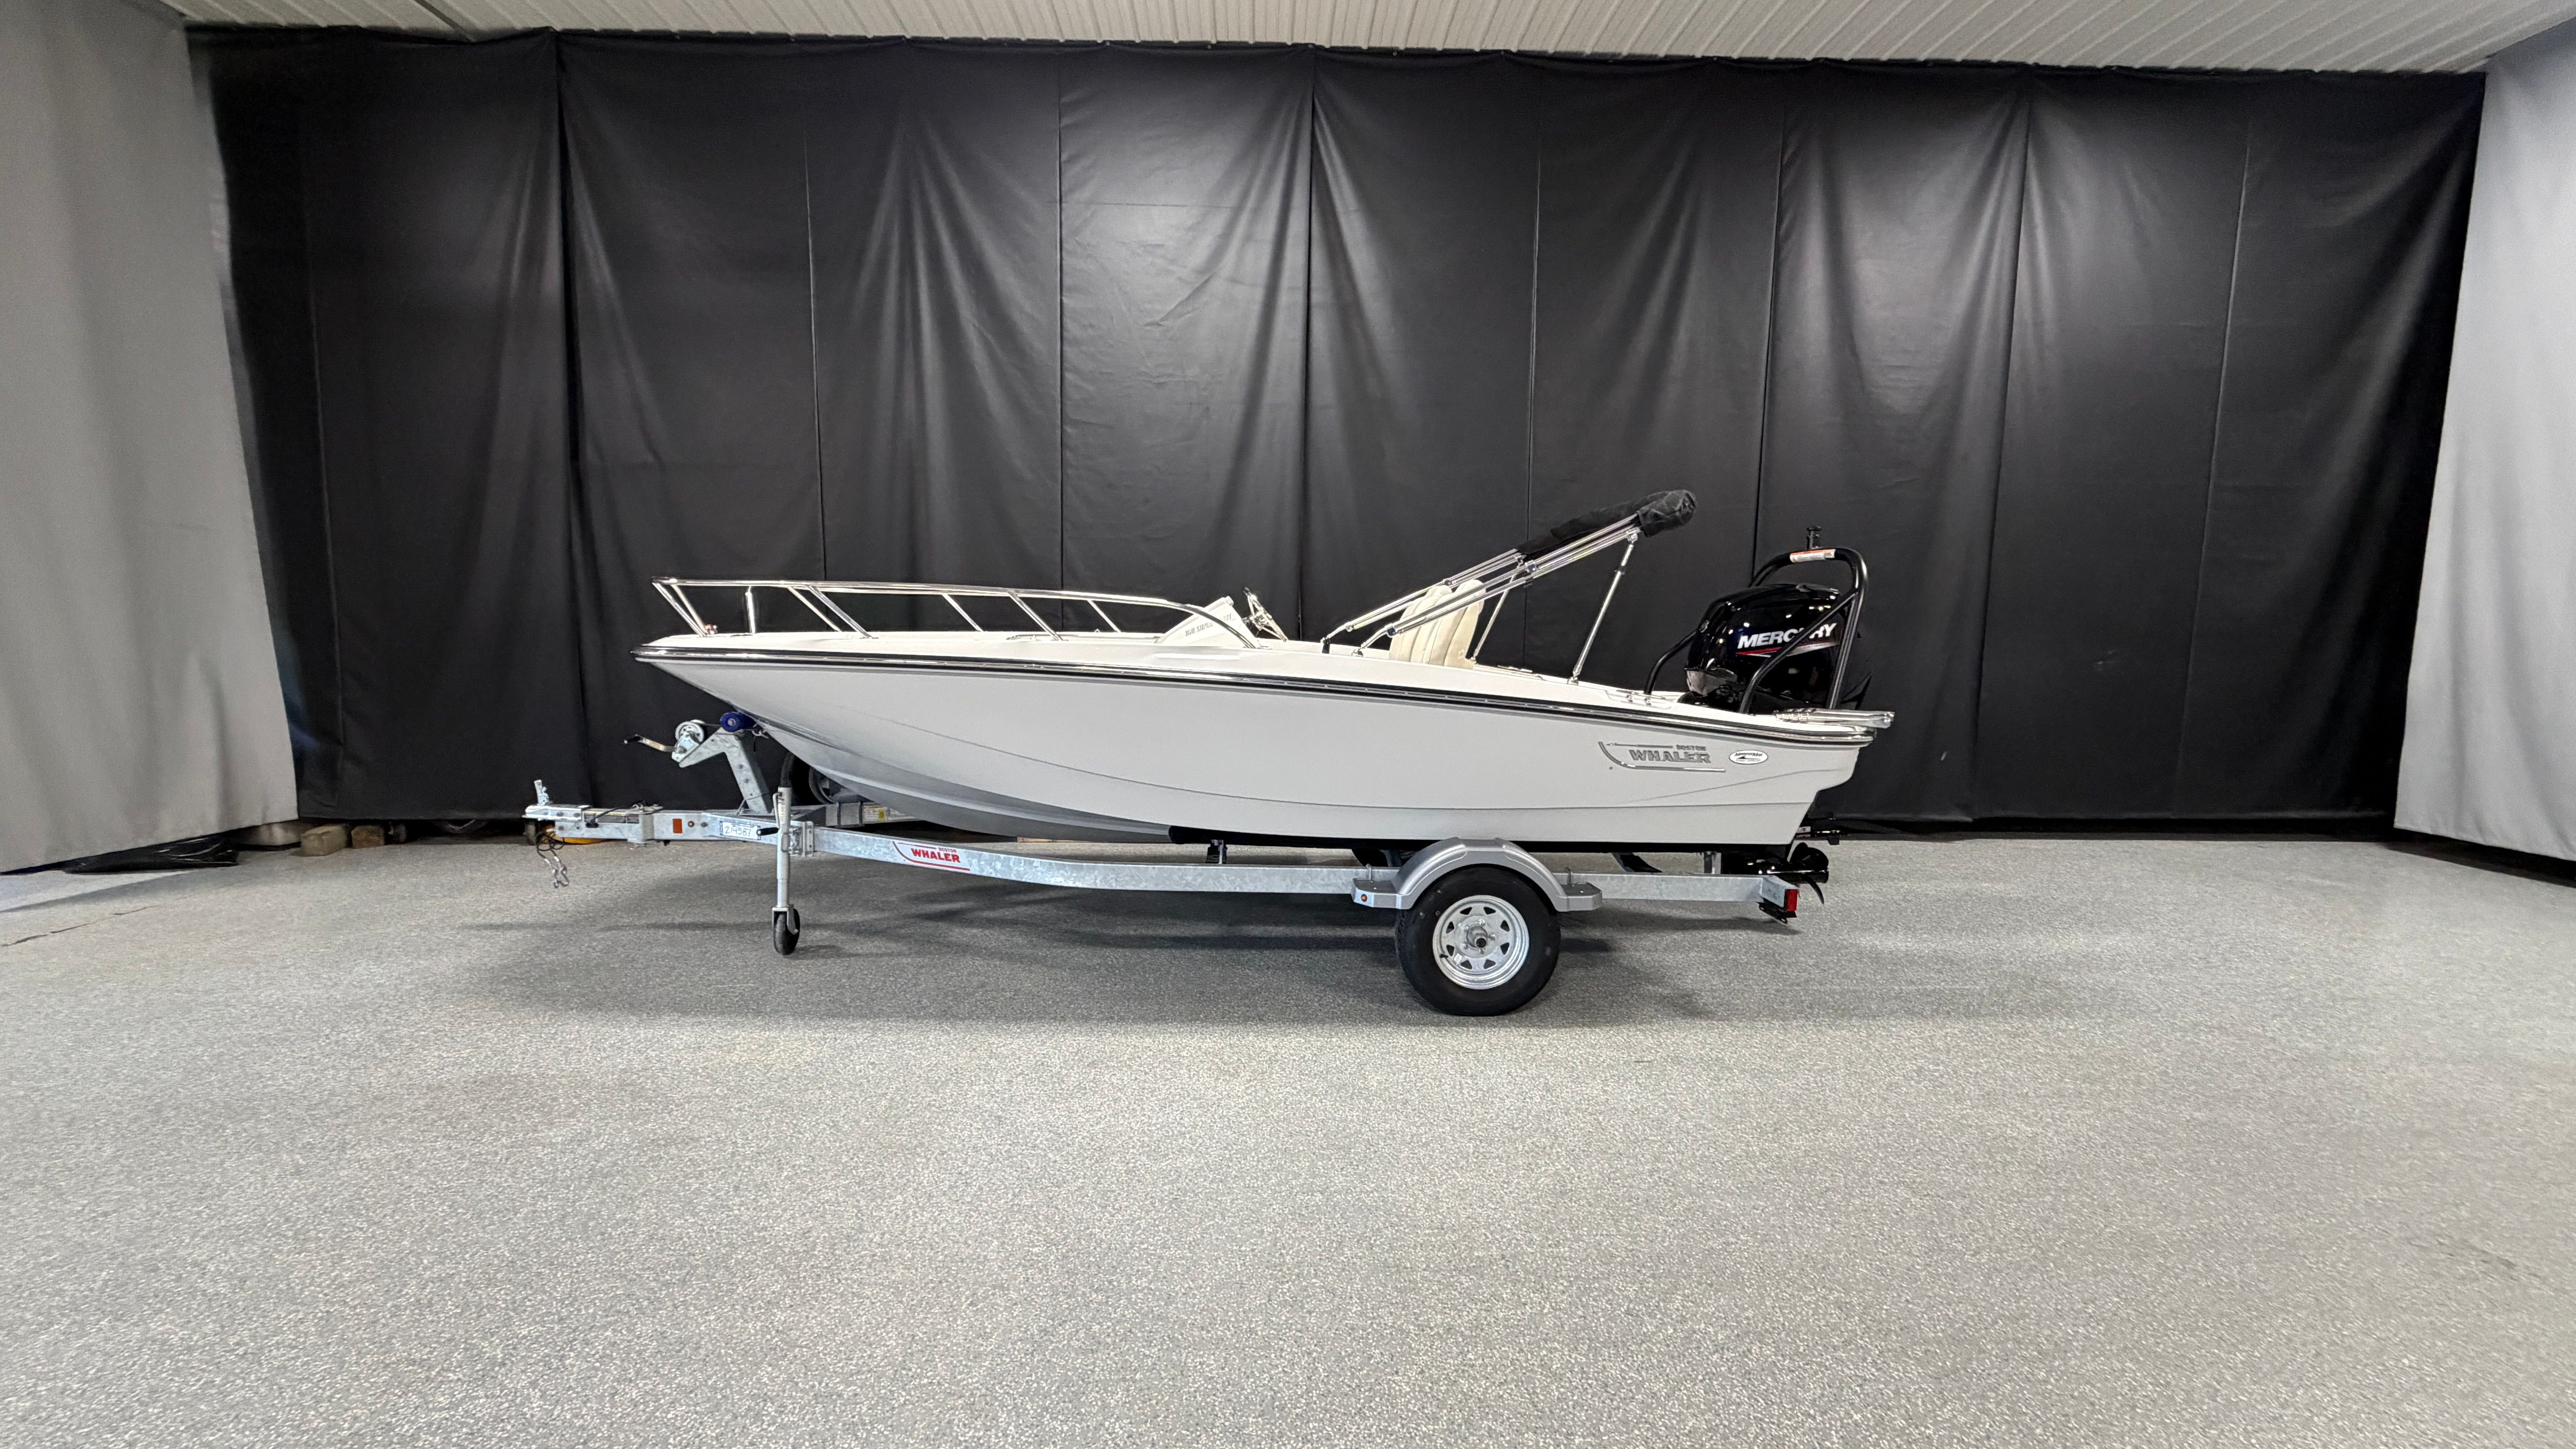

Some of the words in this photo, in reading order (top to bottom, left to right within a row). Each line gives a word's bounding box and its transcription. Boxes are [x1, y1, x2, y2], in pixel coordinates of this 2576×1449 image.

[1737, 623, 1837, 649] MERCRY
[1629, 750, 1711, 764] WHALER
[911, 848, 961, 863] WHALER
